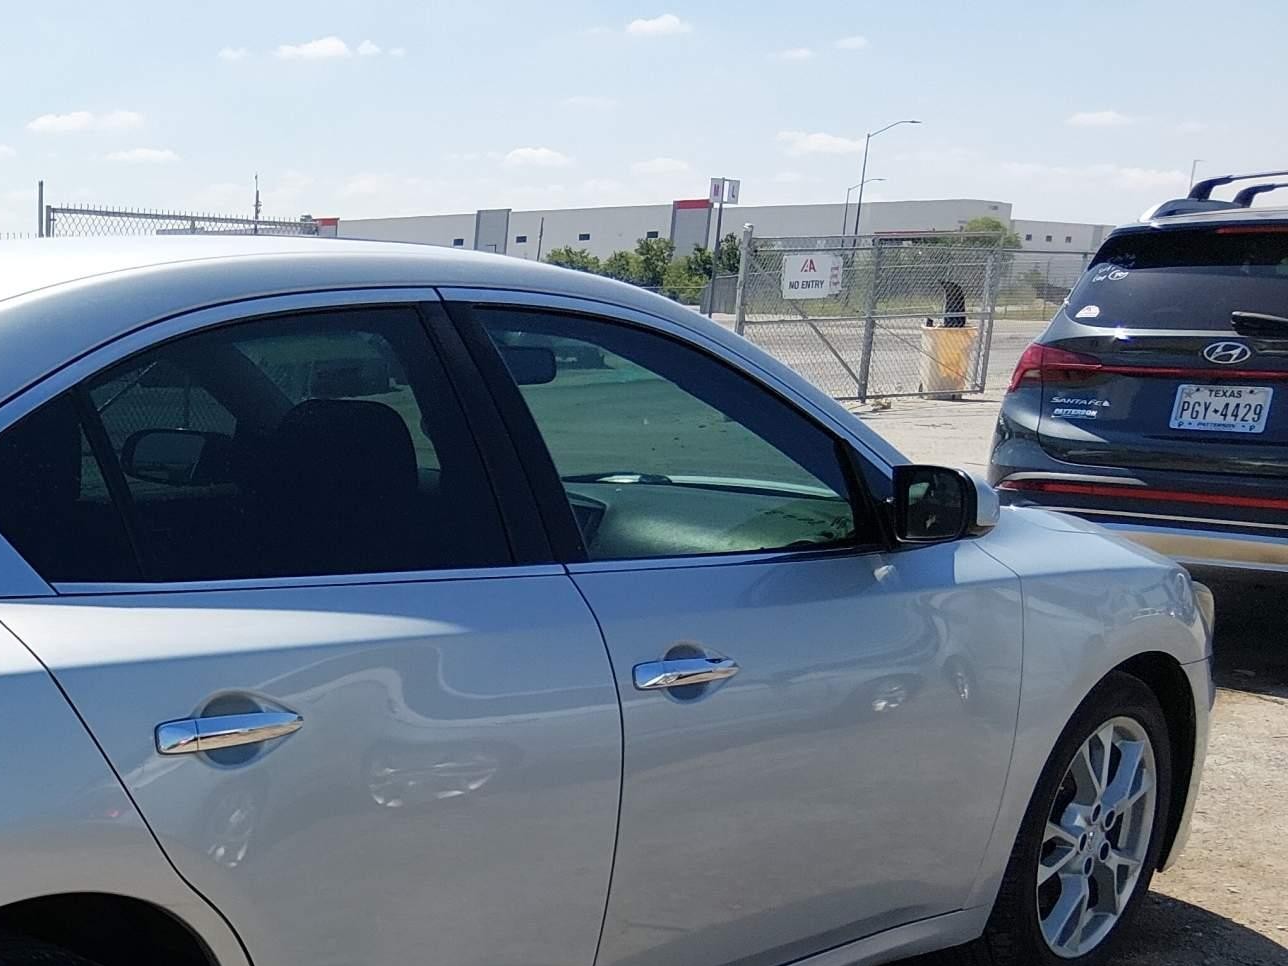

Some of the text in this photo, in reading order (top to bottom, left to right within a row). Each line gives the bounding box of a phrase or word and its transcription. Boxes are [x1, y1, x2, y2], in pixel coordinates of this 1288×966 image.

[788, 280, 825, 290] NO ENTRY
[1208, 389, 1242, 399] TEXAS
[1051, 396, 1088, 405] SANTA
